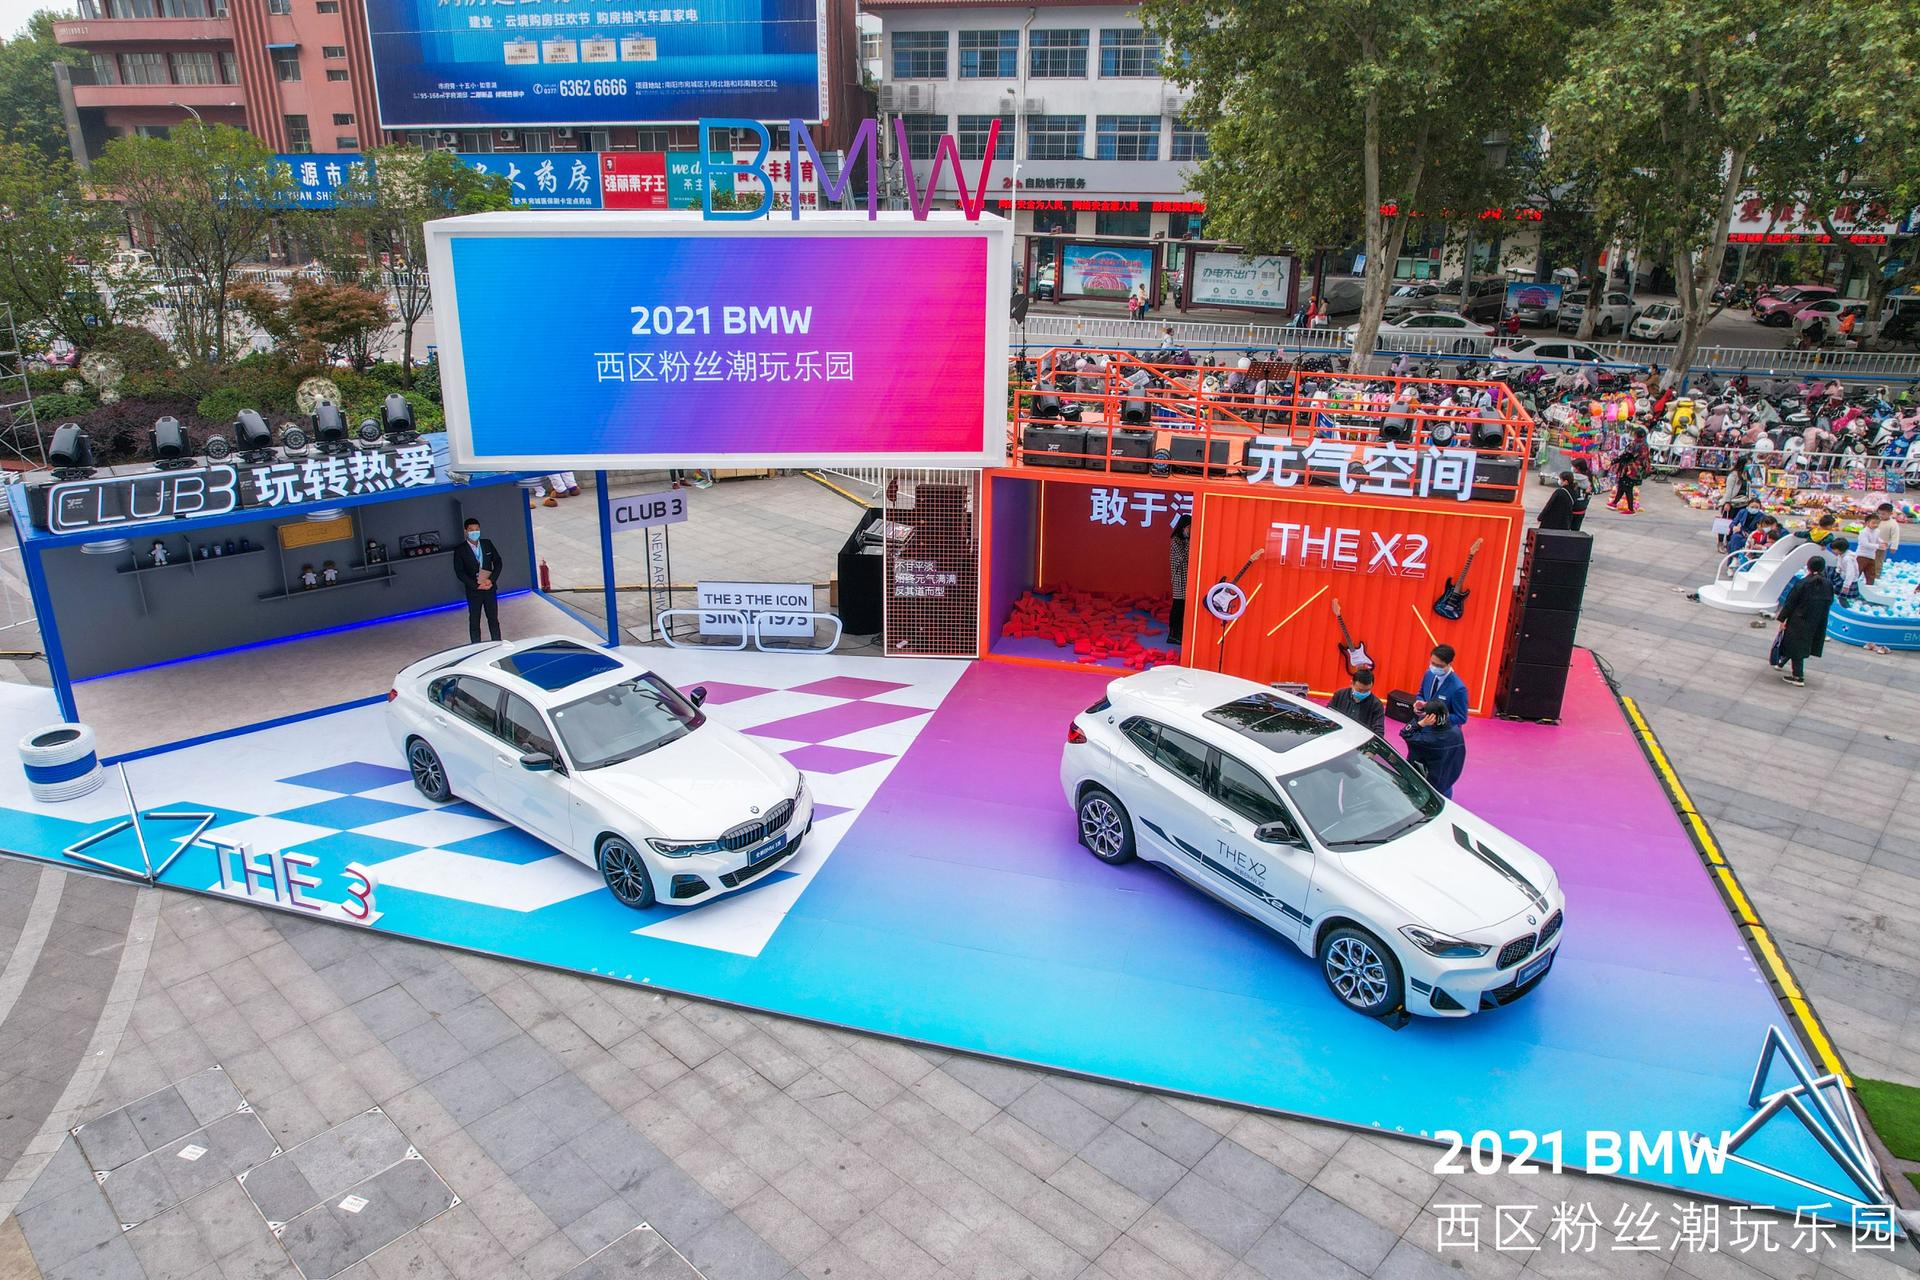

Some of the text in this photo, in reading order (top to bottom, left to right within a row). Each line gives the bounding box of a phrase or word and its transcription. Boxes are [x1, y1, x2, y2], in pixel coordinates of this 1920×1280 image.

[559, 79, 591, 97] 6362
[594, 78, 627, 97] 6666
[604, 174, 666, 193] 强丽栗子王
[699, 118, 1000, 221] BMW
[1025, 178, 1086, 189] 自助银行服务
[630, 306, 812, 335] 2021 BMW
[594, 350, 854, 383] 西区粉丝潮玩乐园
[252, 445, 436, 507] 玩转热爱
[1247, 436, 1477, 502] 元气空间
[615, 498, 683, 524] CLUB 3
[651, 532, 663, 562] NEW
[1271, 522, 1429, 573] THE X2
[704, 593, 808, 607] THE 3 THE ICON
[1217, 839, 1267, 880] THE X2
[198, 833, 377, 920] THE 3
